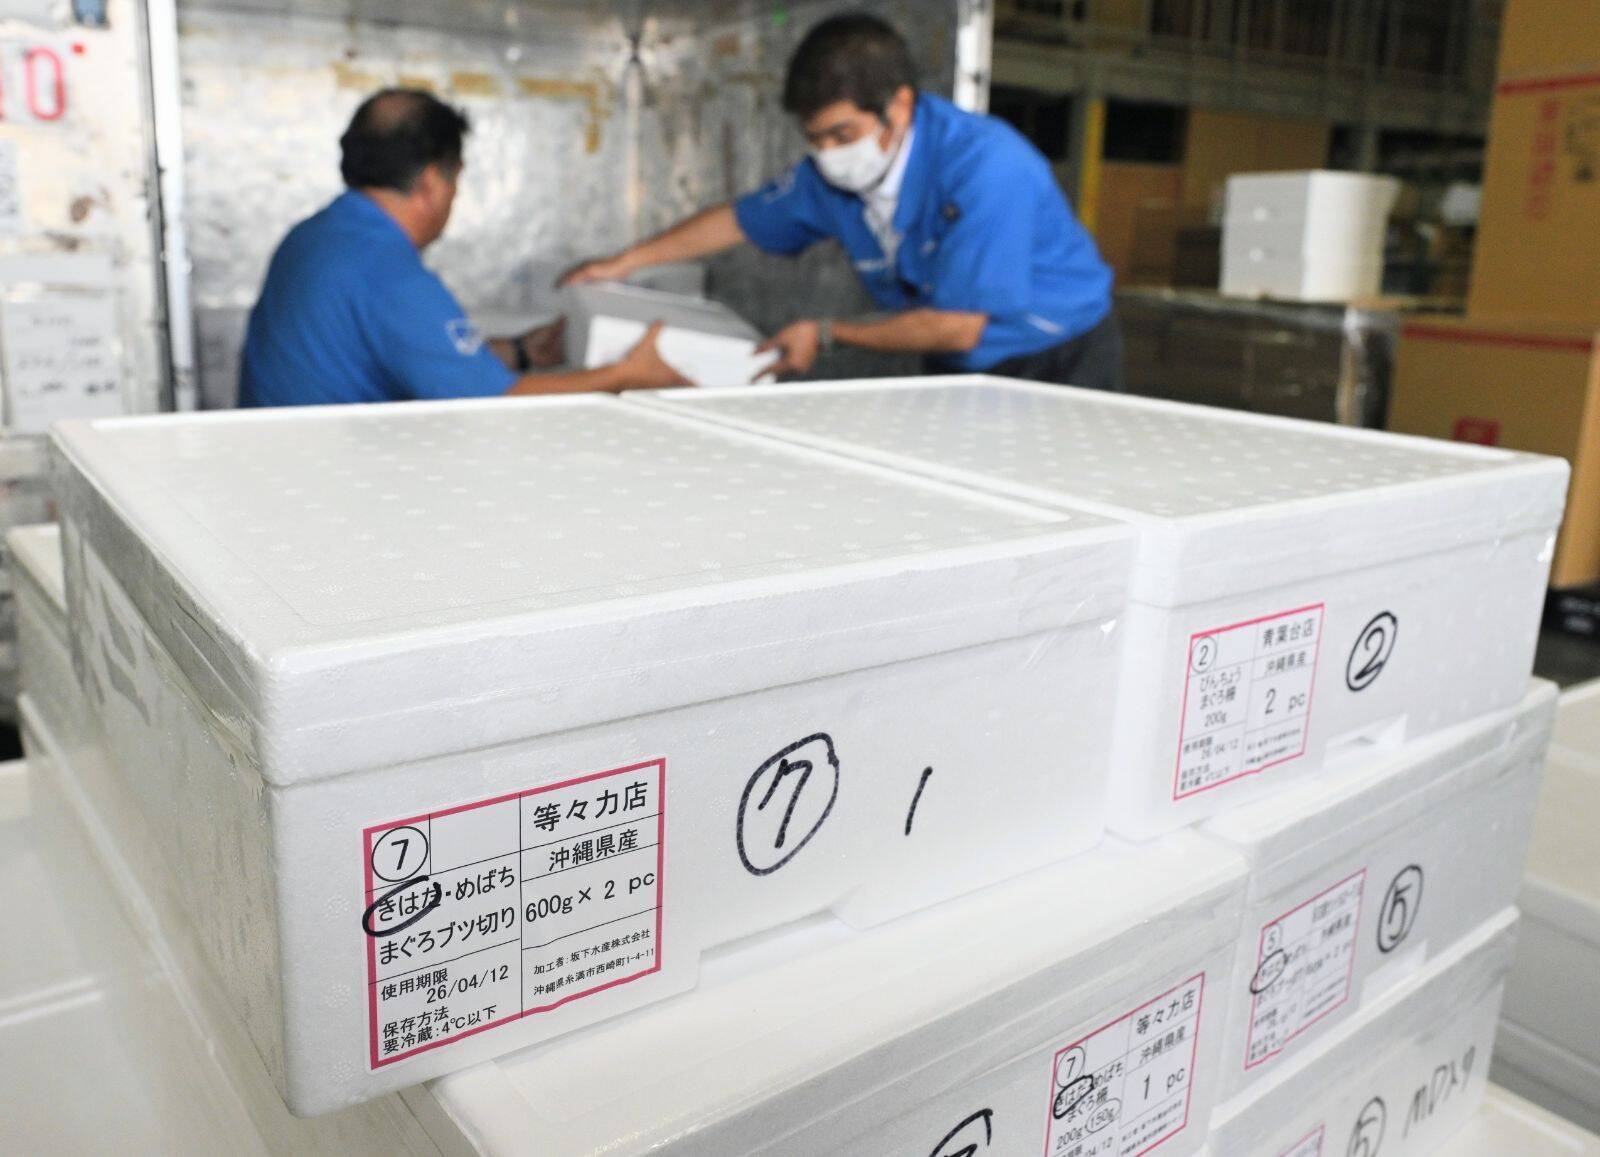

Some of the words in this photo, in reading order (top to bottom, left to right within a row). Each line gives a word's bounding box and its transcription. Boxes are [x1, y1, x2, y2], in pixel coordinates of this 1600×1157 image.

[1264, 688, 1276, 715] 2
[533, 781, 648, 832] 等々力店
[548, 828, 639, 872] 沖縄県産
[524, 896, 573, 923] 600g
[604, 879, 615, 900] 2
[629, 872, 655, 894] pc
[379, 906, 515, 965] まぐろブツ切り
[381, 968, 448, 1001] 使用期限
[426, 964, 509, 1004] 26/04/12
[383, 1005, 450, 1039] 保存方法
[1136, 989, 1196, 1036] 等々力店
[1143, 1074, 1151, 1101] 1
[1166, 1068, 1185, 1093] pc
